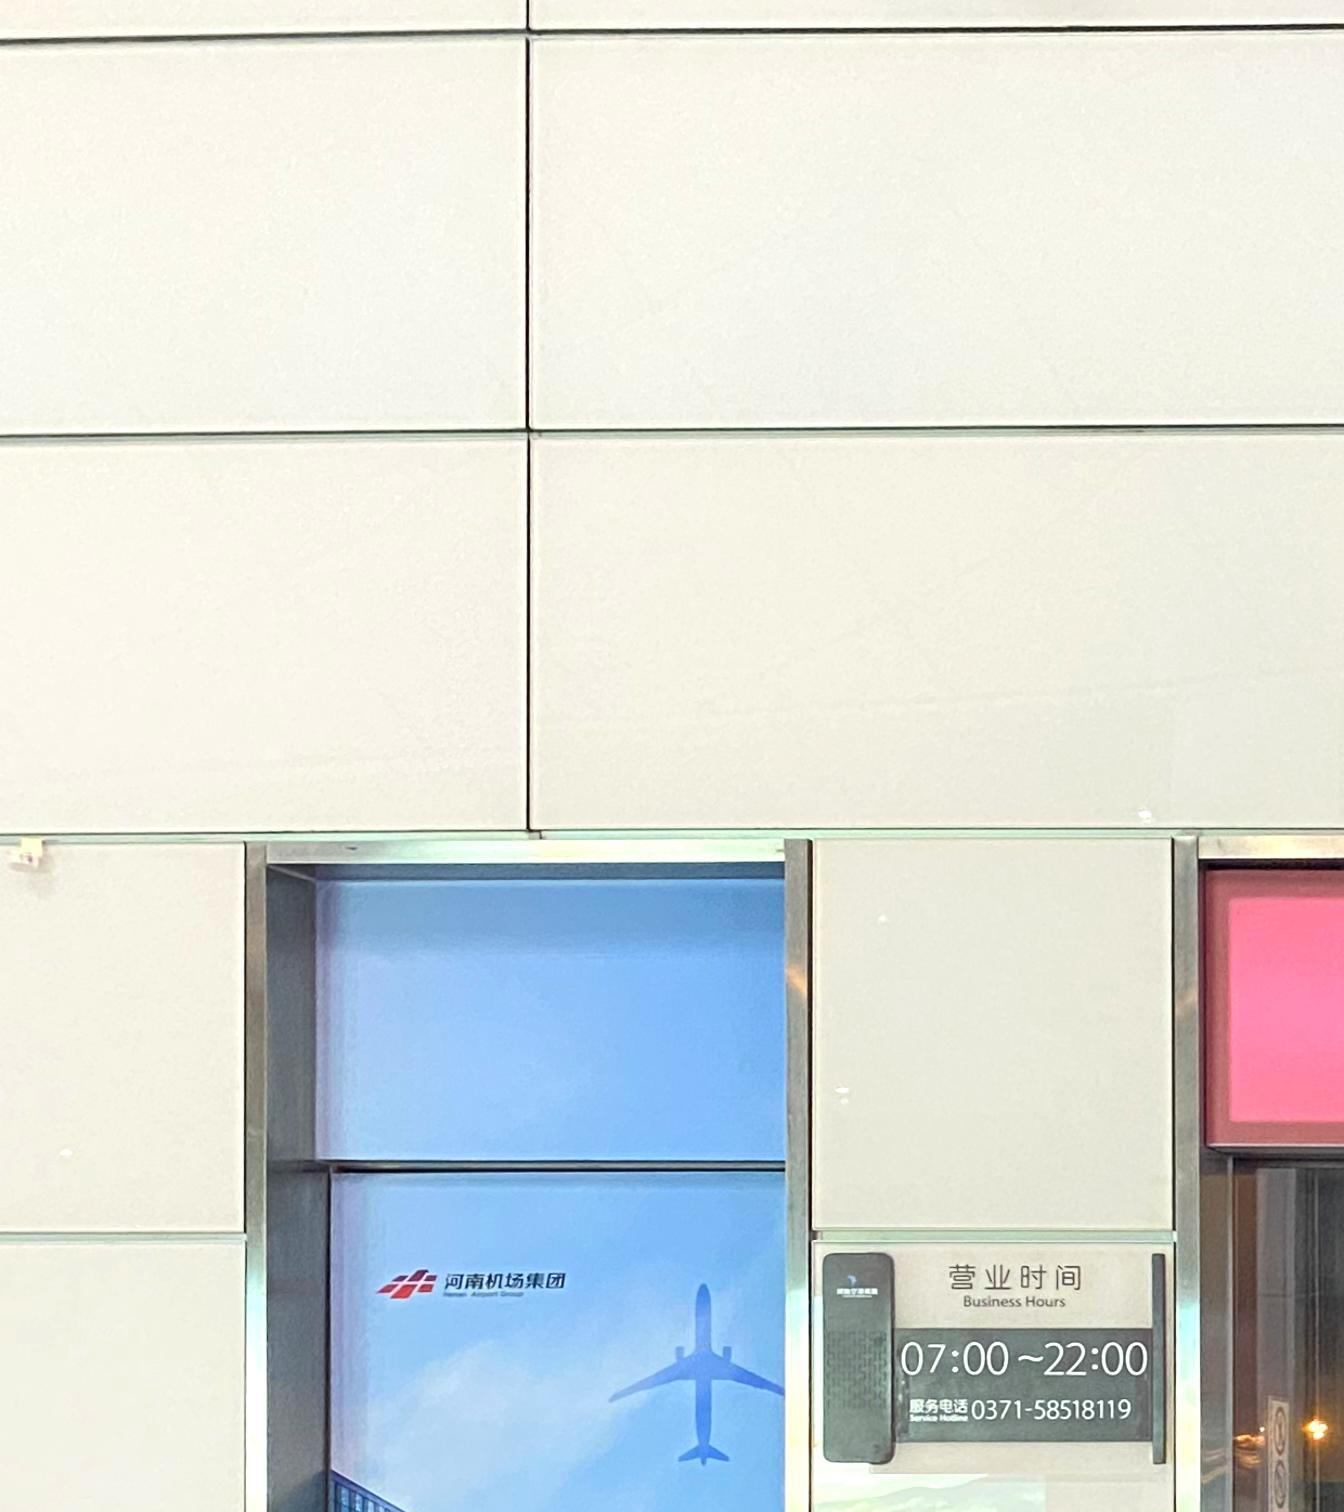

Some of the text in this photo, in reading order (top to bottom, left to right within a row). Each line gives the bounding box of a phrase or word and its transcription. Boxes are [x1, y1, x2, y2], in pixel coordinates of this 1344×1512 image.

[444, 1272, 566, 1290] 河南机场集团
[948, 1264, 1083, 1290] 营业时间
[962, 1295, 1067, 1308] Business Hours
[909, 1398, 1132, 1420] 服务电话 0371-58518119
